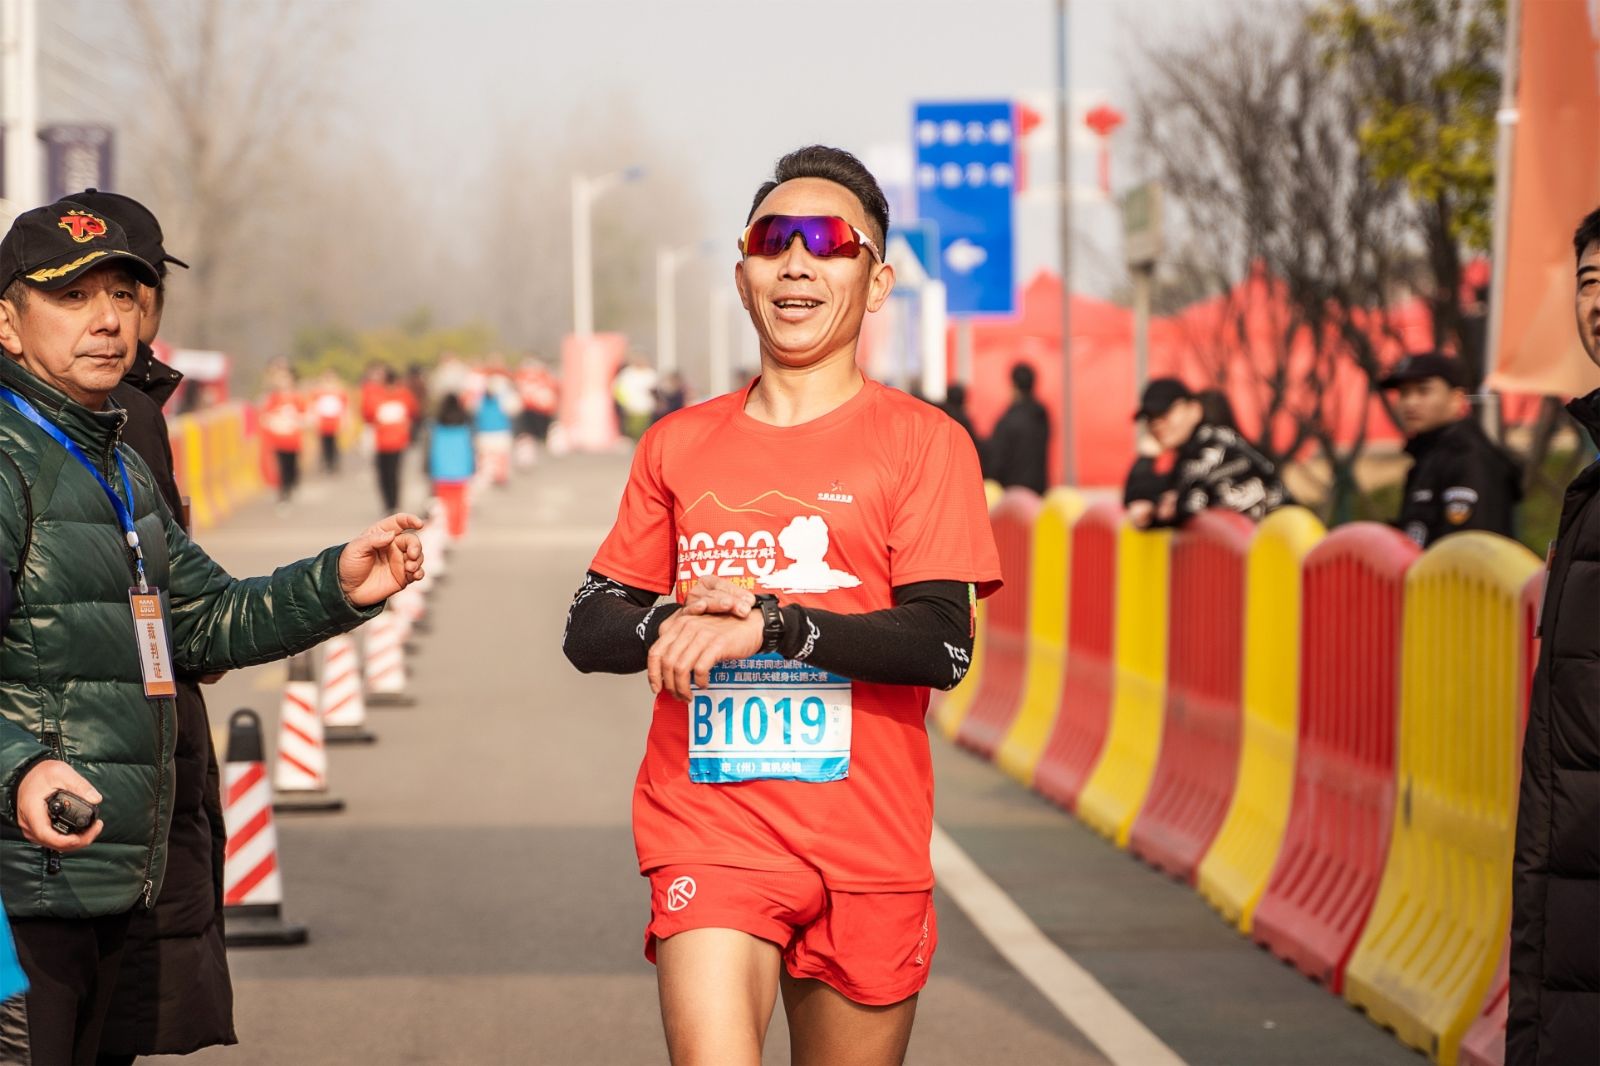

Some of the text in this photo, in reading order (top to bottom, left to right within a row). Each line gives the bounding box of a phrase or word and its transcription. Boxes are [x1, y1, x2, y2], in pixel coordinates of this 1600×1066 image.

[943, 642, 969, 664] TCS
[707, 671, 829, 682] （市）直属机关健身长跑大赛
[694, 695, 826, 745] B1019
